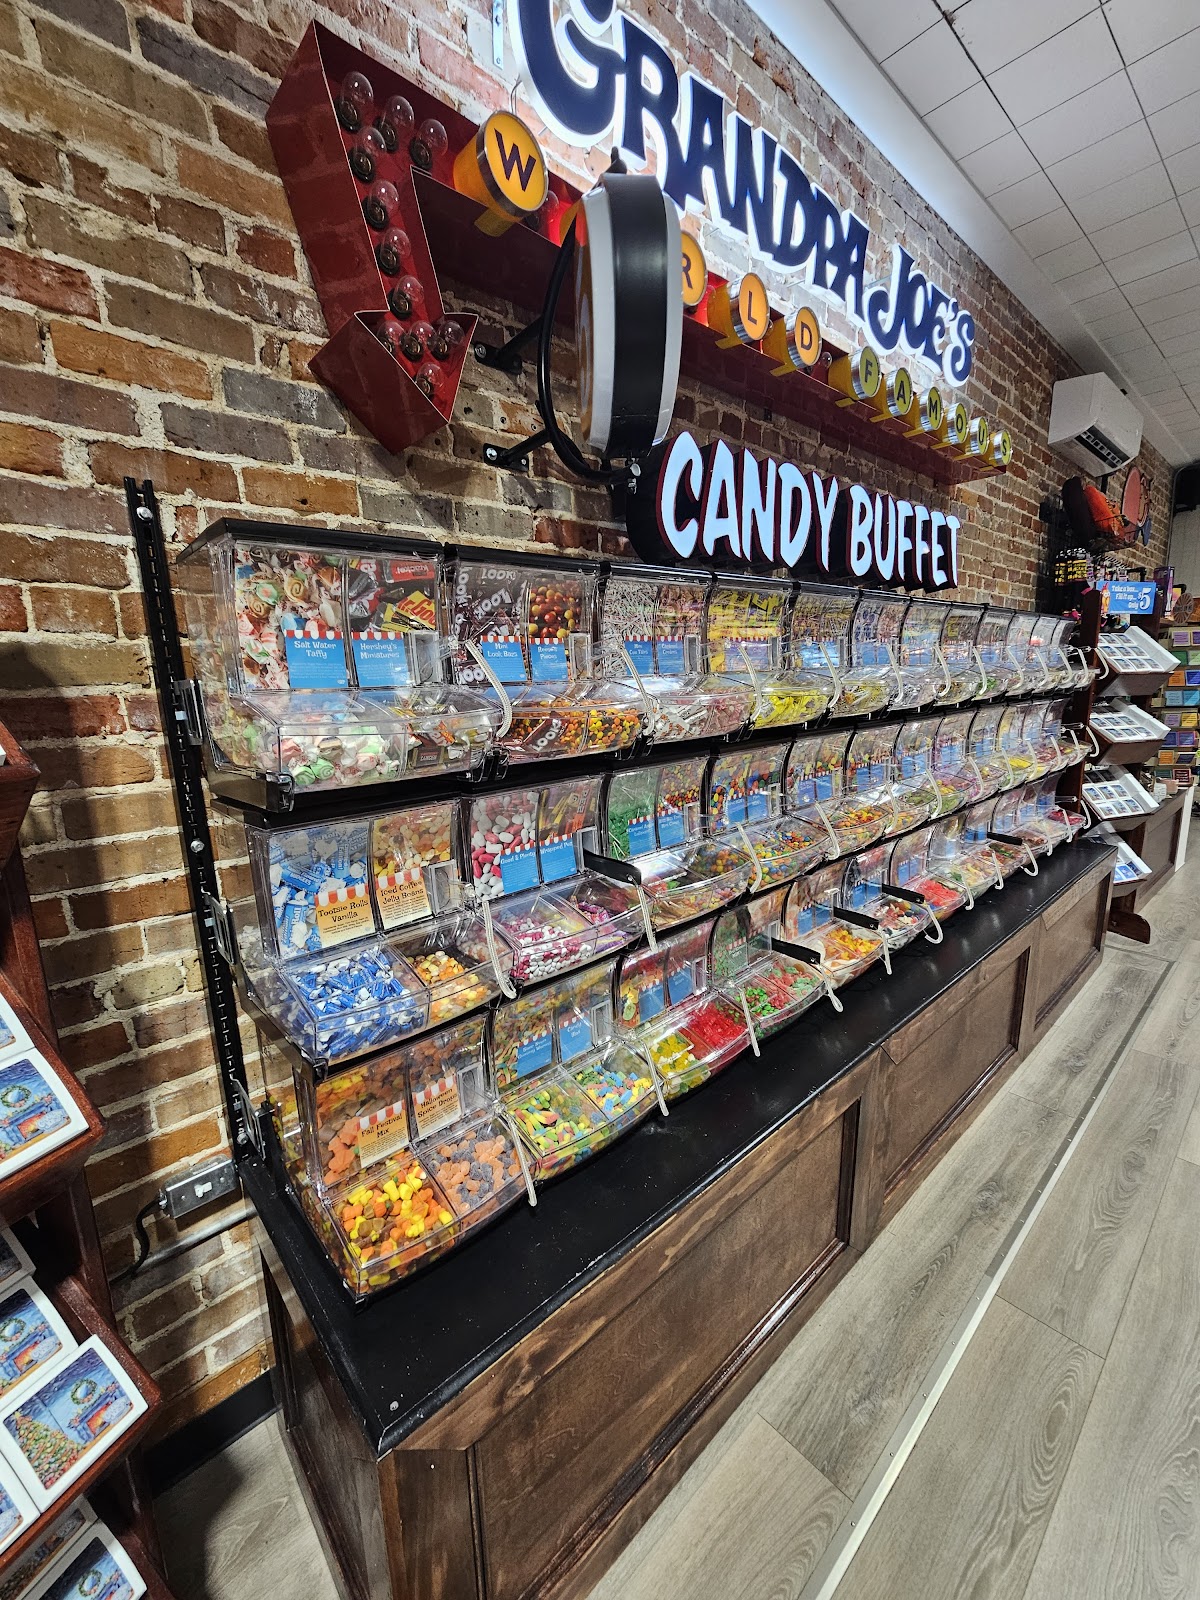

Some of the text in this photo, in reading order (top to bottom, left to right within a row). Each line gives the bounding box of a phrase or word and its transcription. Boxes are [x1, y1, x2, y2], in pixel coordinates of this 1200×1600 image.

[516, 0, 976, 384] GRANDPA JOE'S
[494, 127, 1008, 457] WRLD FAMOUS
[661, 431, 961, 587] CANDY BUFFET
[294, 641, 337, 650] Salt Water
[360, 642, 398, 652] Hershey's
[306, 650, 328, 659] Taffy
[360, 651, 400, 660] Miniatures
[500, 856, 514, 866] Good
[520, 851, 536, 860] Plenty
[380, 880, 422, 897] Iced Coffee
[382, 888, 424, 905] Jelly Beans
[318, 900, 369, 917] Tootsie Rolls
[331, 911, 358, 923] Vanilla
[417, 1093, 458, 1118] Spice Drops
[420, 1088, 453, 1109] Halloween
[362, 1126, 375, 1138] Fall
[376, 1113, 403, 1131] Festival
[376, 1128, 390, 1139] Mix
